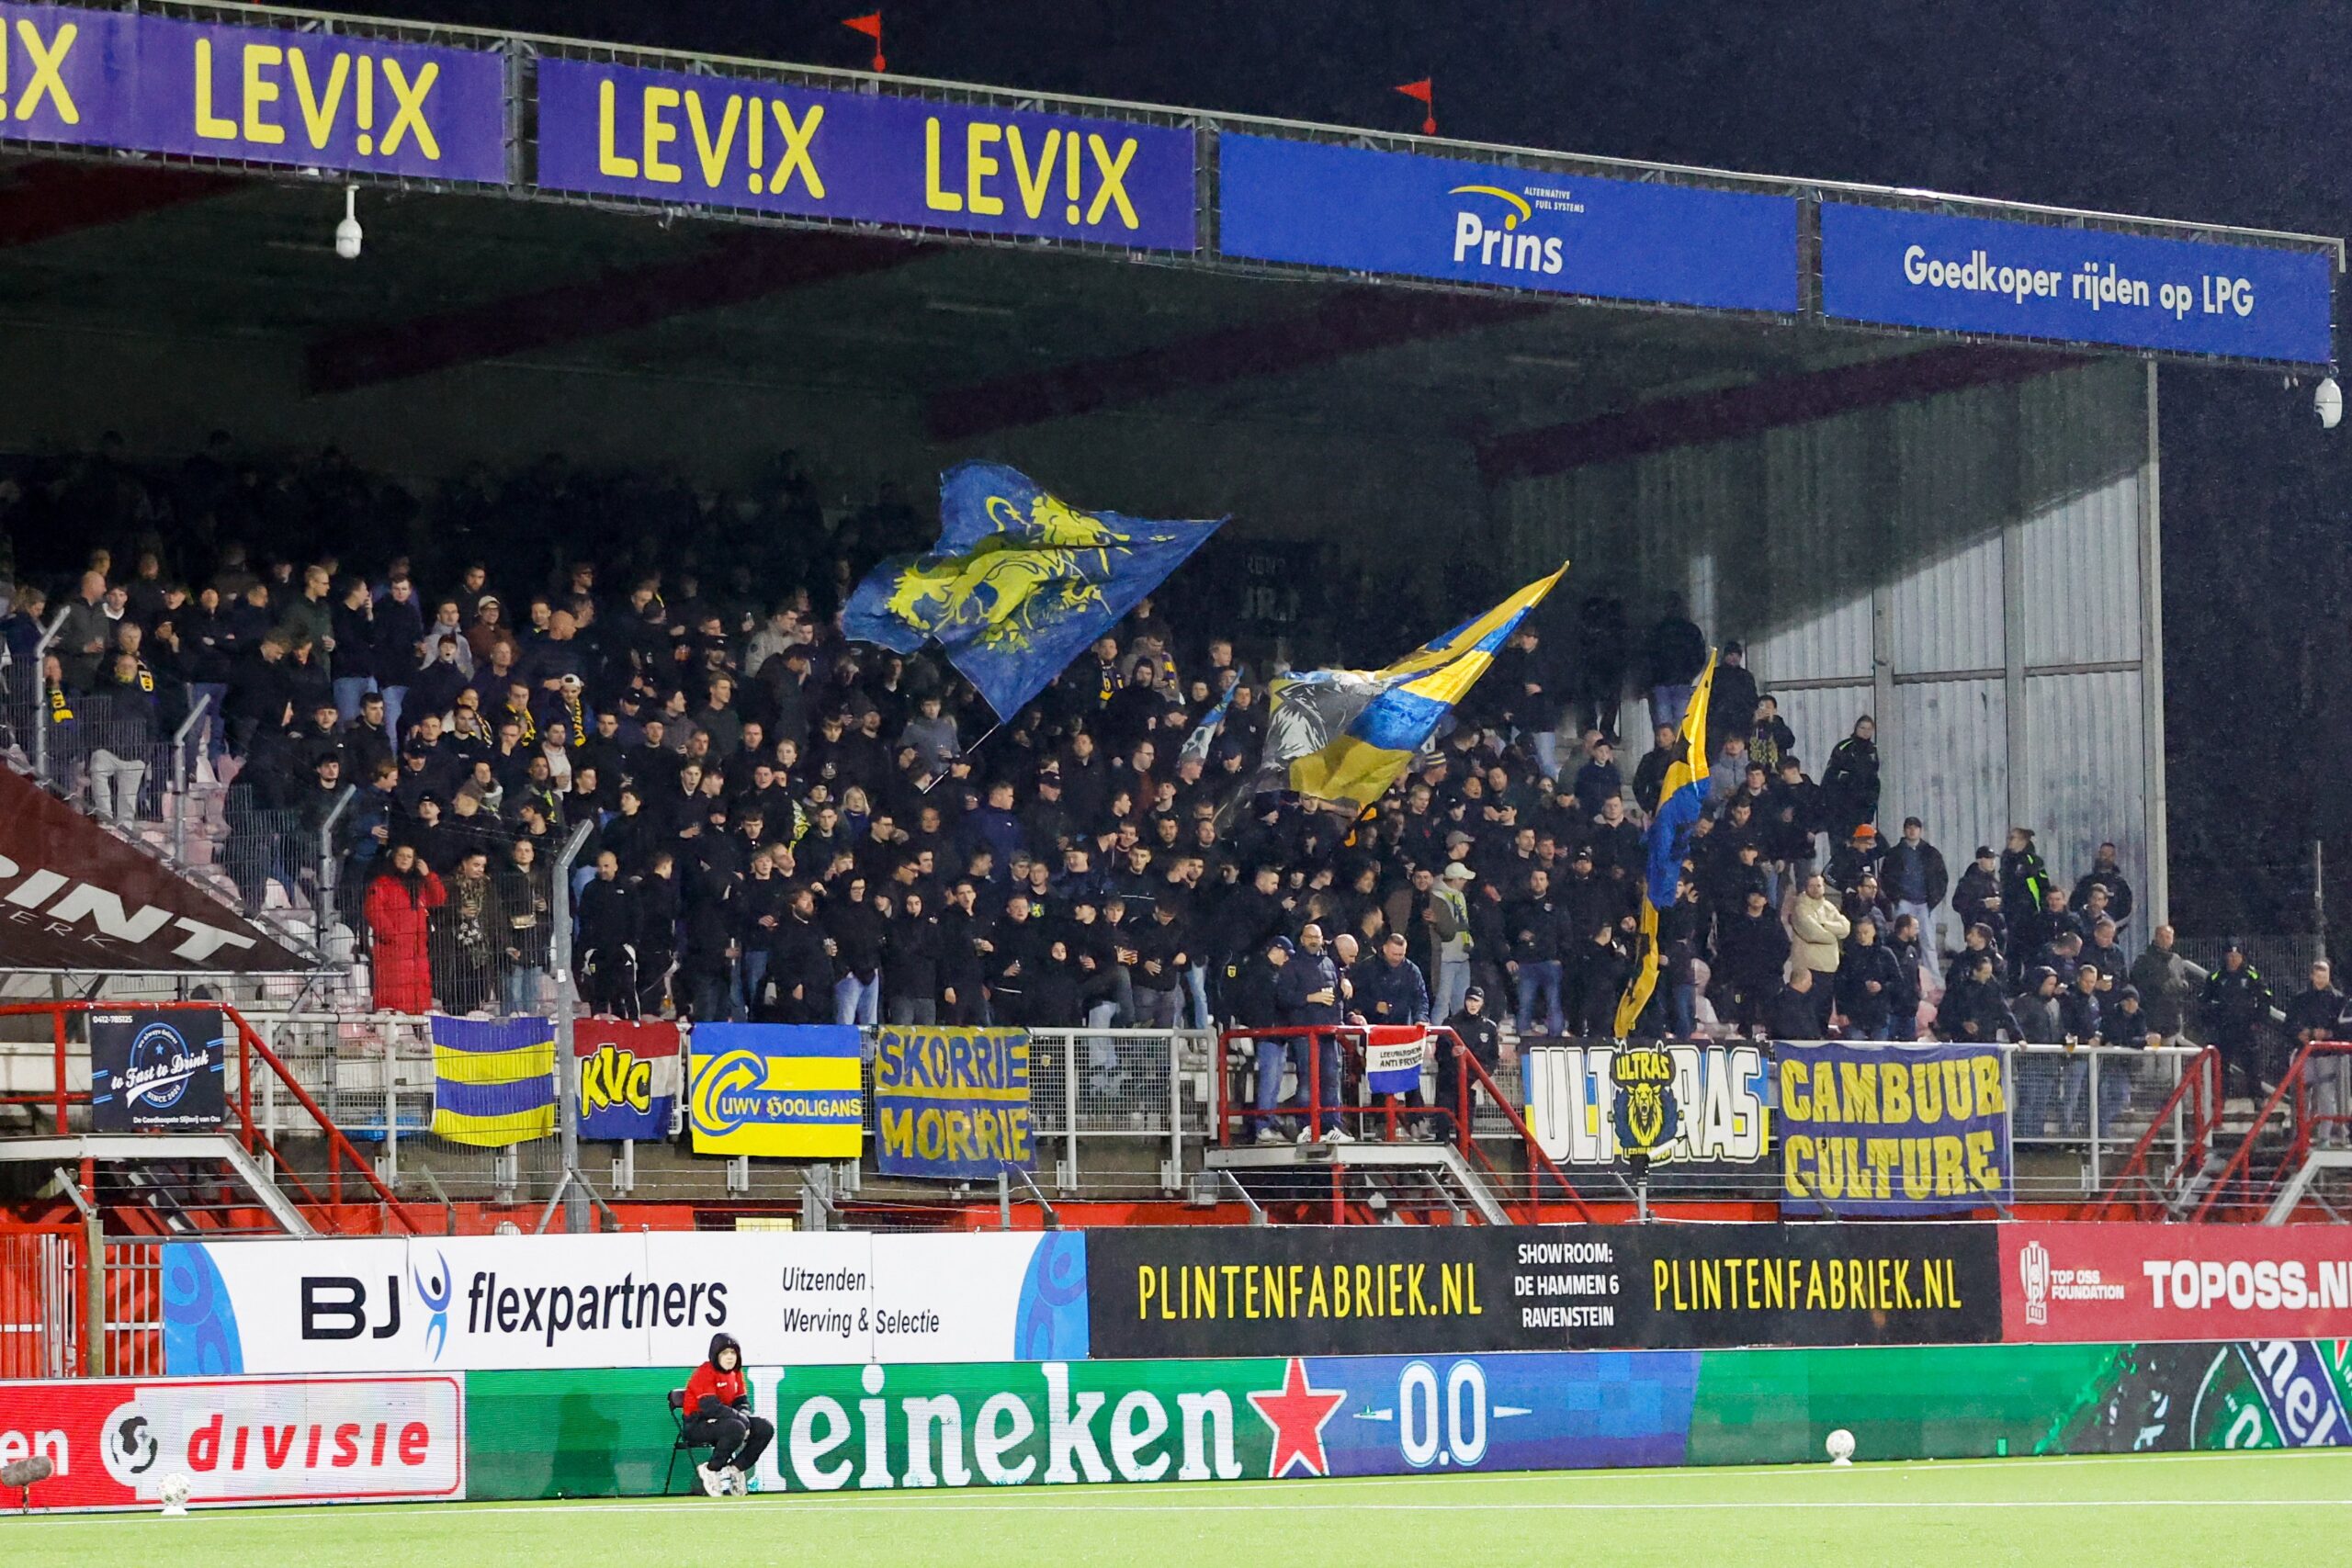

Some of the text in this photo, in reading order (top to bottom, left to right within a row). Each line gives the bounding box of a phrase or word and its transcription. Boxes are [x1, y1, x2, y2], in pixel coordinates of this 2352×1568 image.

[195, 38, 440, 161] LEV!X
[599, 79, 825, 199] LEV!X
[925, 117, 1139, 231] LEV!X
[1524, 186, 1571, 199] ALTERNATIVE
[1535, 199, 1585, 213] FUEL SYSTEMS
[1453, 211, 1563, 275] Prins
[1904, 244, 2254, 320] Goedkoper rijden op LPG
[0, 904, 116, 948] ERK
[111, 1050, 209, 1089] to Fast to Drink
[581, 1043, 652, 1121] KVC
[880, 1034, 1029, 1089] SKORRIE
[1380, 1059, 1398, 1067] ANTI
[1616, 1052, 1670, 1081] ULTRAS
[147, 1090, 167, 1103] SINCE
[722, 1098, 761, 1115] UWV
[1781, 1055, 2006, 1123] CAMBUUR
[881, 1107, 1031, 1161] MORRIE
[1784, 1130, 2001, 1200] CULTURE
[1518, 1242, 1613, 1264] SHOWROOM:
[2051, 1270, 2100, 1284] TOP OSS
[783, 1267, 866, 1292] Uitzenden
[1138, 1262, 1483, 1320] PLINTENFABRIEK.NL
[1514, 1274, 1620, 1296] DE HAMMEN 6
[1654, 1258, 1962, 1311] PLINTENFABRIEK.NL
[2052, 1285, 2124, 1300] FOUNDATION
[2143, 1259, 2352, 1310] TOPOSS.N
[301, 1271, 729, 1348] BJ flexpartners
[784, 1307, 940, 1337] Werving & Selectie
[1521, 1305, 1614, 1328] RAVENSTEIN
[1398, 1359, 1487, 1468] 0.0
[187, 1414, 430, 1472] divisie
